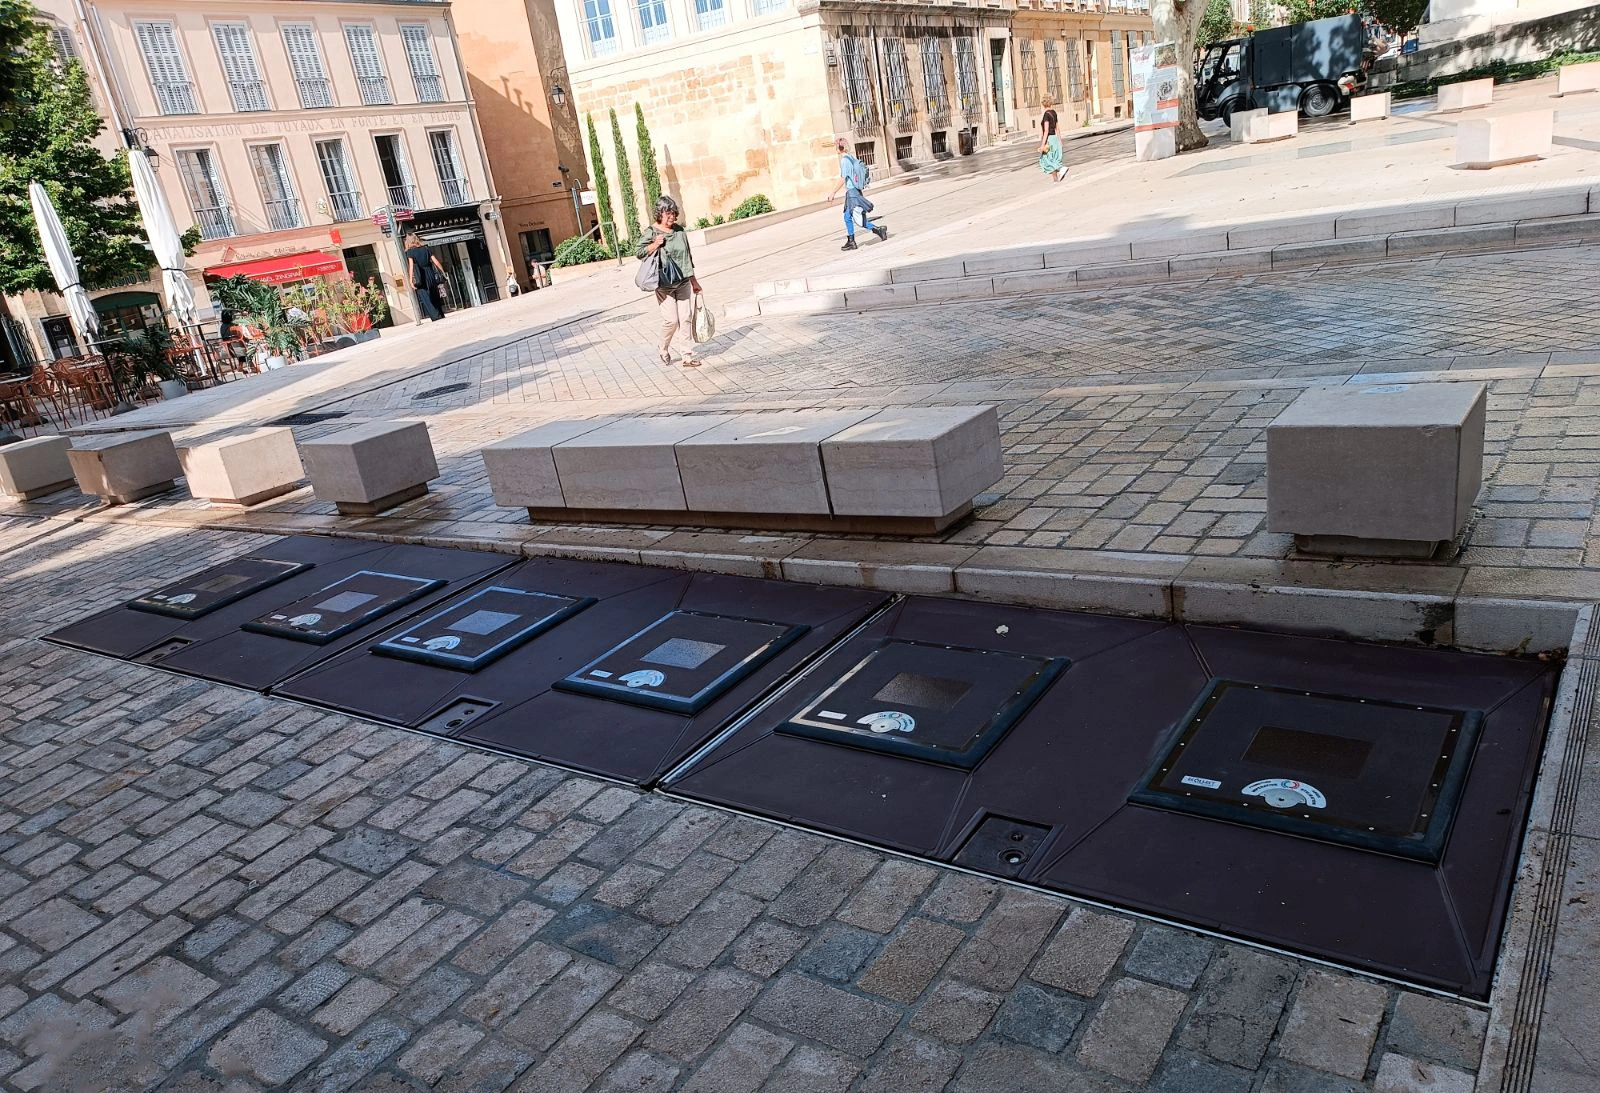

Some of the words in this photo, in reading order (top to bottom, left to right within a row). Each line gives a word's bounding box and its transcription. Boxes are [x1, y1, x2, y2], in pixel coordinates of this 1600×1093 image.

[147, 125, 242, 143] CANALISATION
[251, 123, 267, 135] DE
[277, 119, 324, 133] TUYAUX
[330, 118, 345, 129] EN
[351, 115, 386, 127] FONTE
[392, 113, 405, 124] ET
[412, 113, 424, 123] EN
[430, 111, 460, 122] PLOMB
